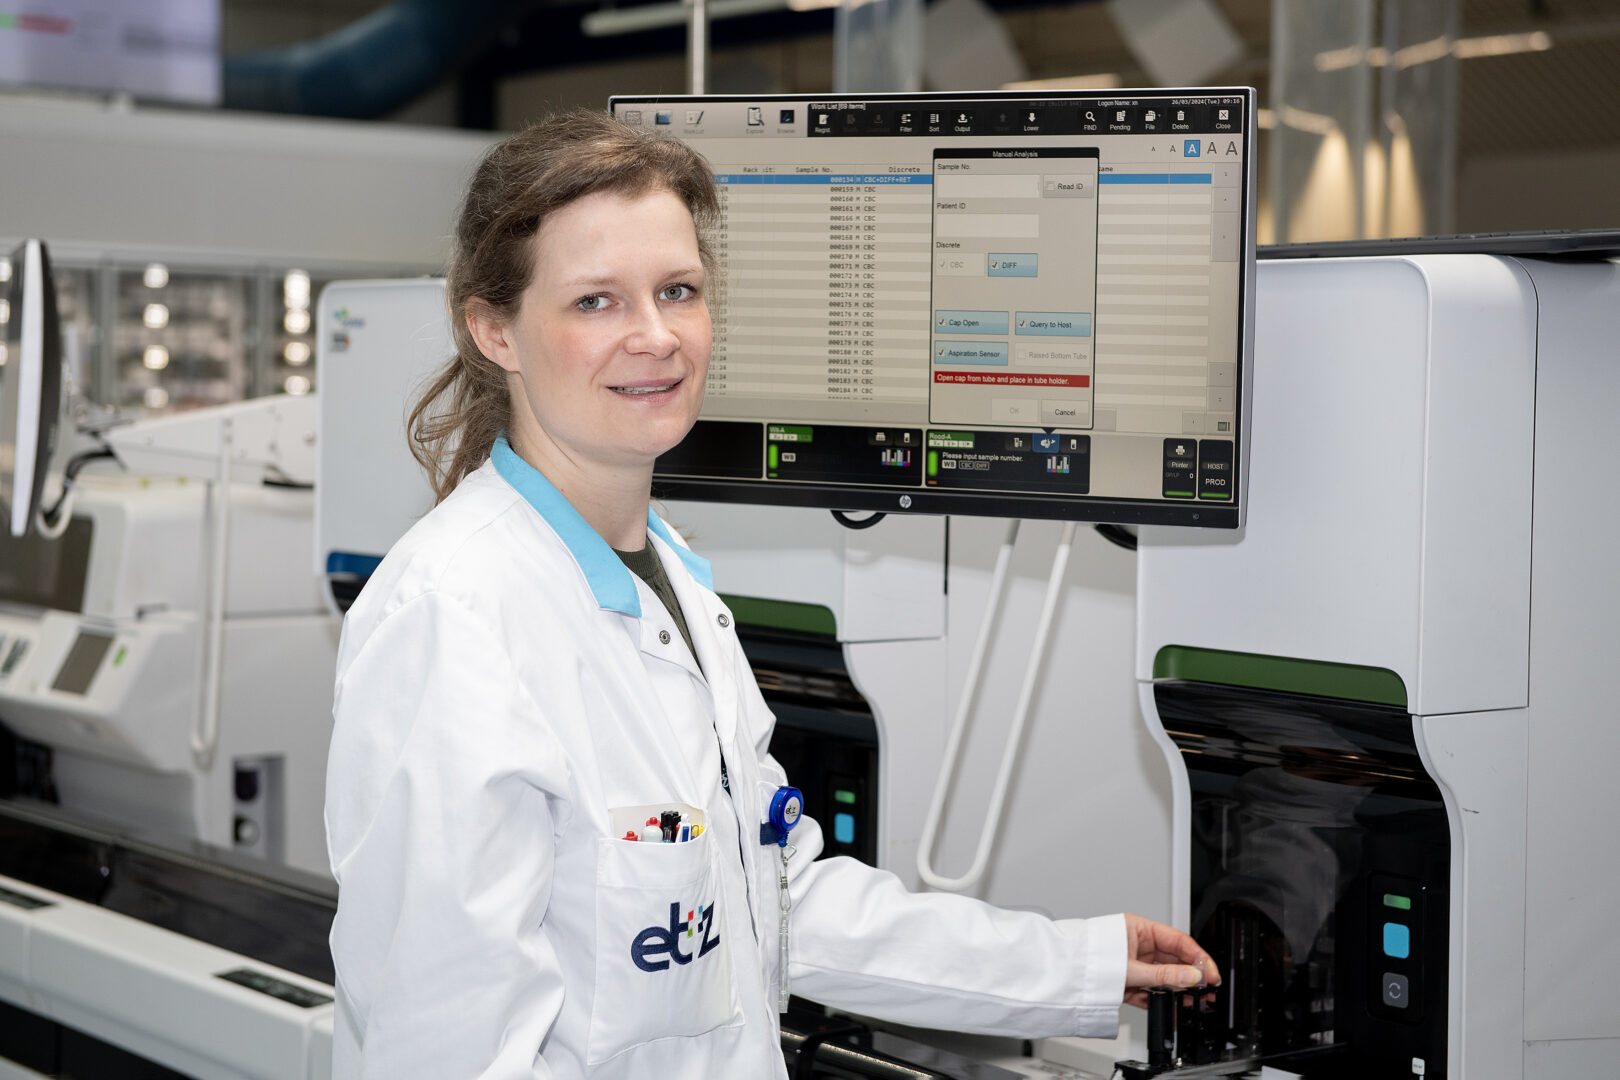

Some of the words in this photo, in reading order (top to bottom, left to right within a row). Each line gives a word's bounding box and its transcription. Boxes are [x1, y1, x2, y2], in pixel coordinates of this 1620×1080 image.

[1188, 144, 1197, 154] A
[1207, 142, 1217, 154] A
[1225, 141, 1238, 156] A
[1030, 321, 1048, 329] Query
[948, 350, 978, 358] Aspiration
[1009, 376, 1026, 384] place
